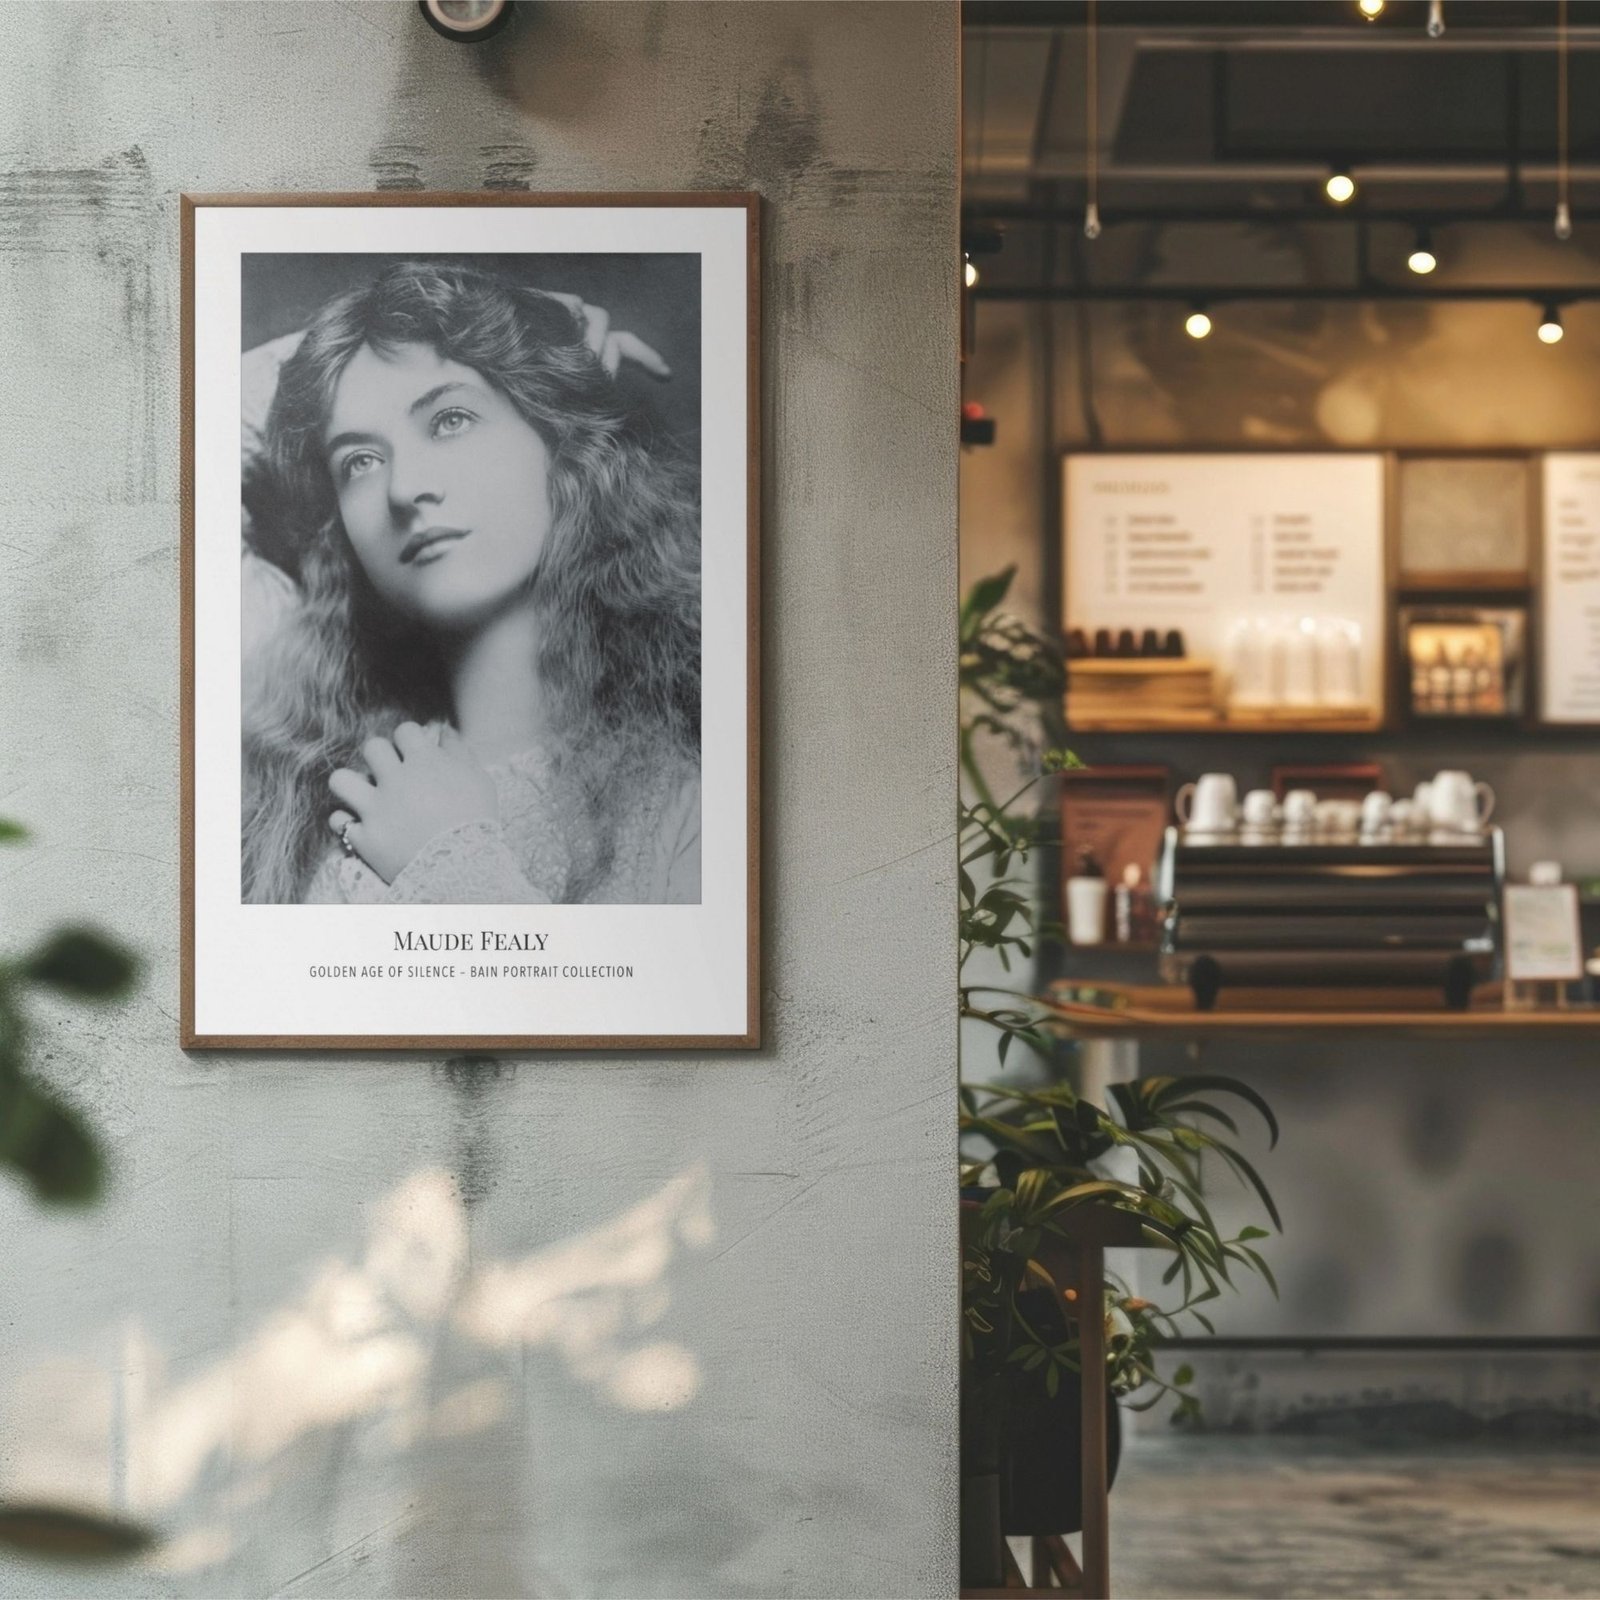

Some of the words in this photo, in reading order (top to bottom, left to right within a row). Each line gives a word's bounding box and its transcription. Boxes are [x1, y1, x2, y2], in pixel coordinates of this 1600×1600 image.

[309, 965, 357, 978] GOLDEN
[361, 965, 383, 978] AGE
[388, 965, 403, 978] OF
[407, 965, 455, 978] SILENCE
[470, 965, 498, 978] BAIN
[503, 965, 558, 978] PORTRAIT
[562, 965, 634, 978] COLLECTION
